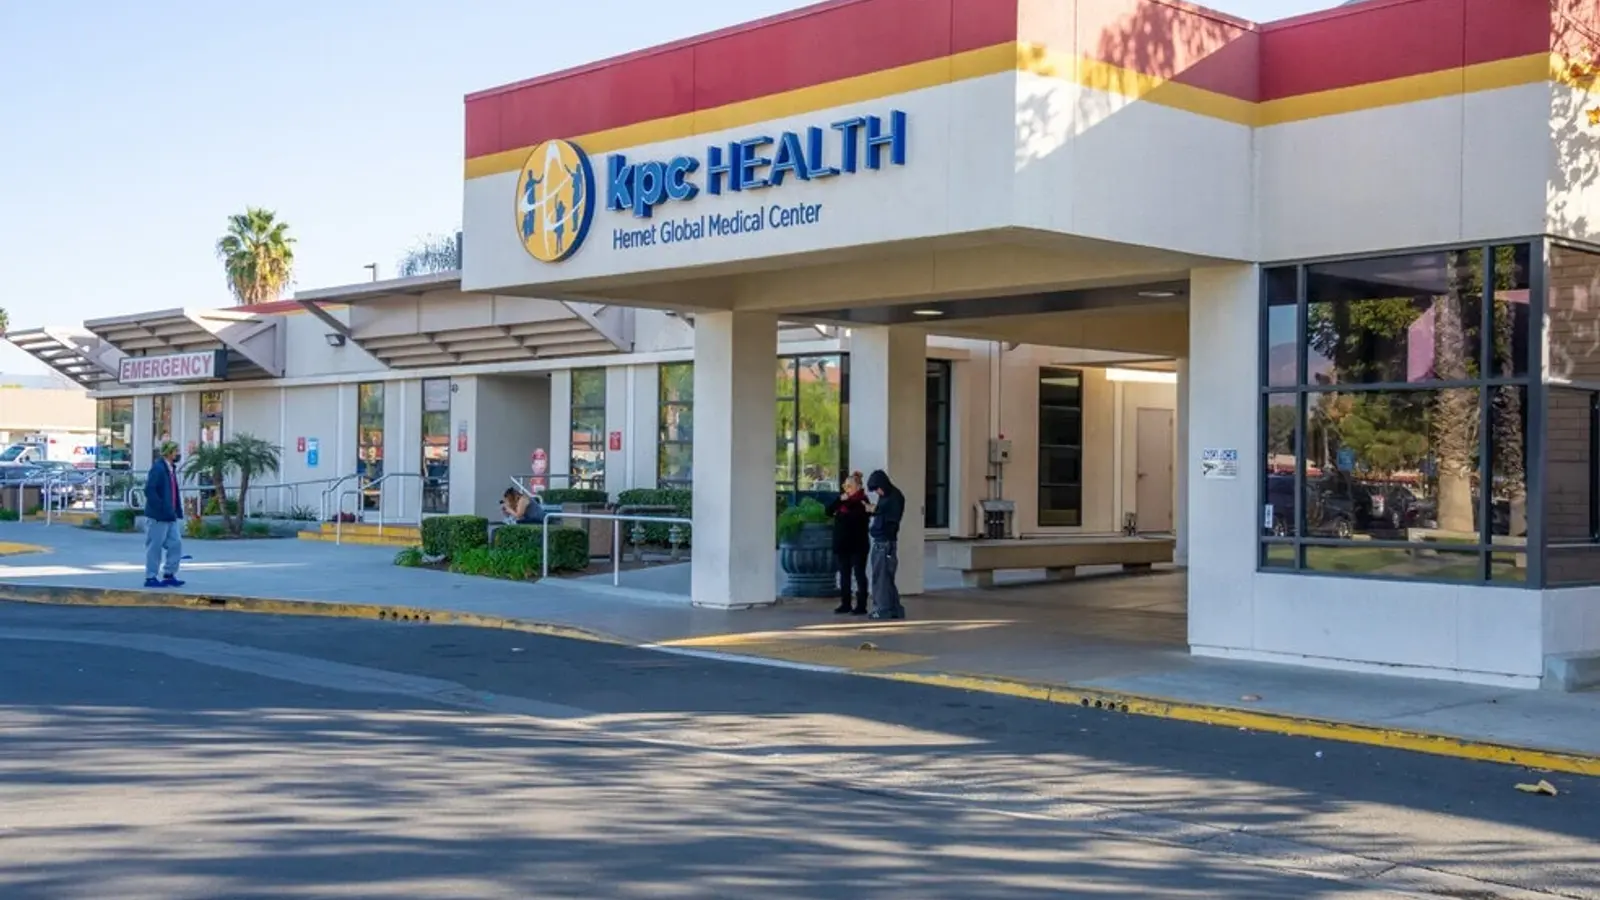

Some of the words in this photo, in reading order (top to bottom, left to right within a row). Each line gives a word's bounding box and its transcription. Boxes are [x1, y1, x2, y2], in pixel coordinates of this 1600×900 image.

[606, 153, 699, 217] kpc
[706, 109, 906, 195] HEALTH
[613, 226, 657, 250] Hemet
[660, 216, 704, 244] Global
[708, 207, 764, 237] Medical
[769, 203, 822, 228] Center
[121, 355, 212, 380] EMERGENCY
